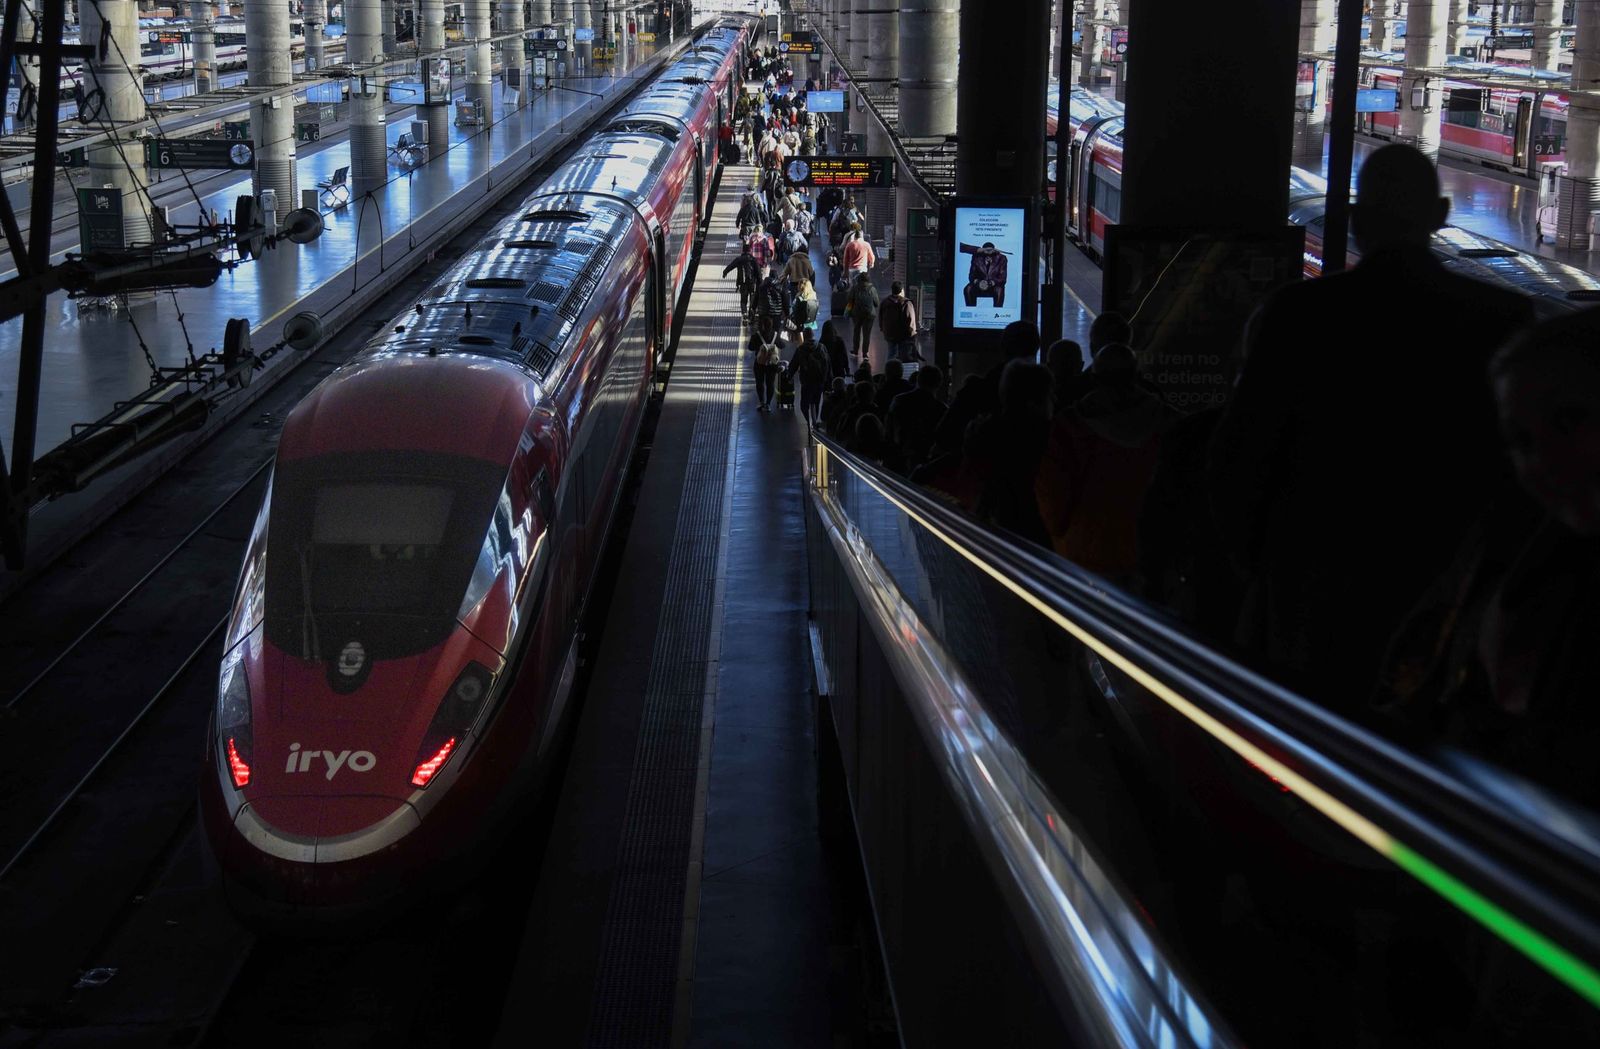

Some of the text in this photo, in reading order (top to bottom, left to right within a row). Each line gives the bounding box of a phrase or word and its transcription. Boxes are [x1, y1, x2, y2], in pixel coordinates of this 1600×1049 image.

[227, 131, 242, 139] 5 A
[842, 143, 858, 152] 7 A
[1535, 144, 1554, 154] 9 A
[64, 151, 72, 163] 5
[161, 151, 169, 165] 6
[874, 169, 881, 183] 7
[1158, 352, 1193, 365] tren
[1198, 354, 1221, 366] no
[1158, 370, 1227, 384] detiene.
[285, 742, 377, 781] iryo
